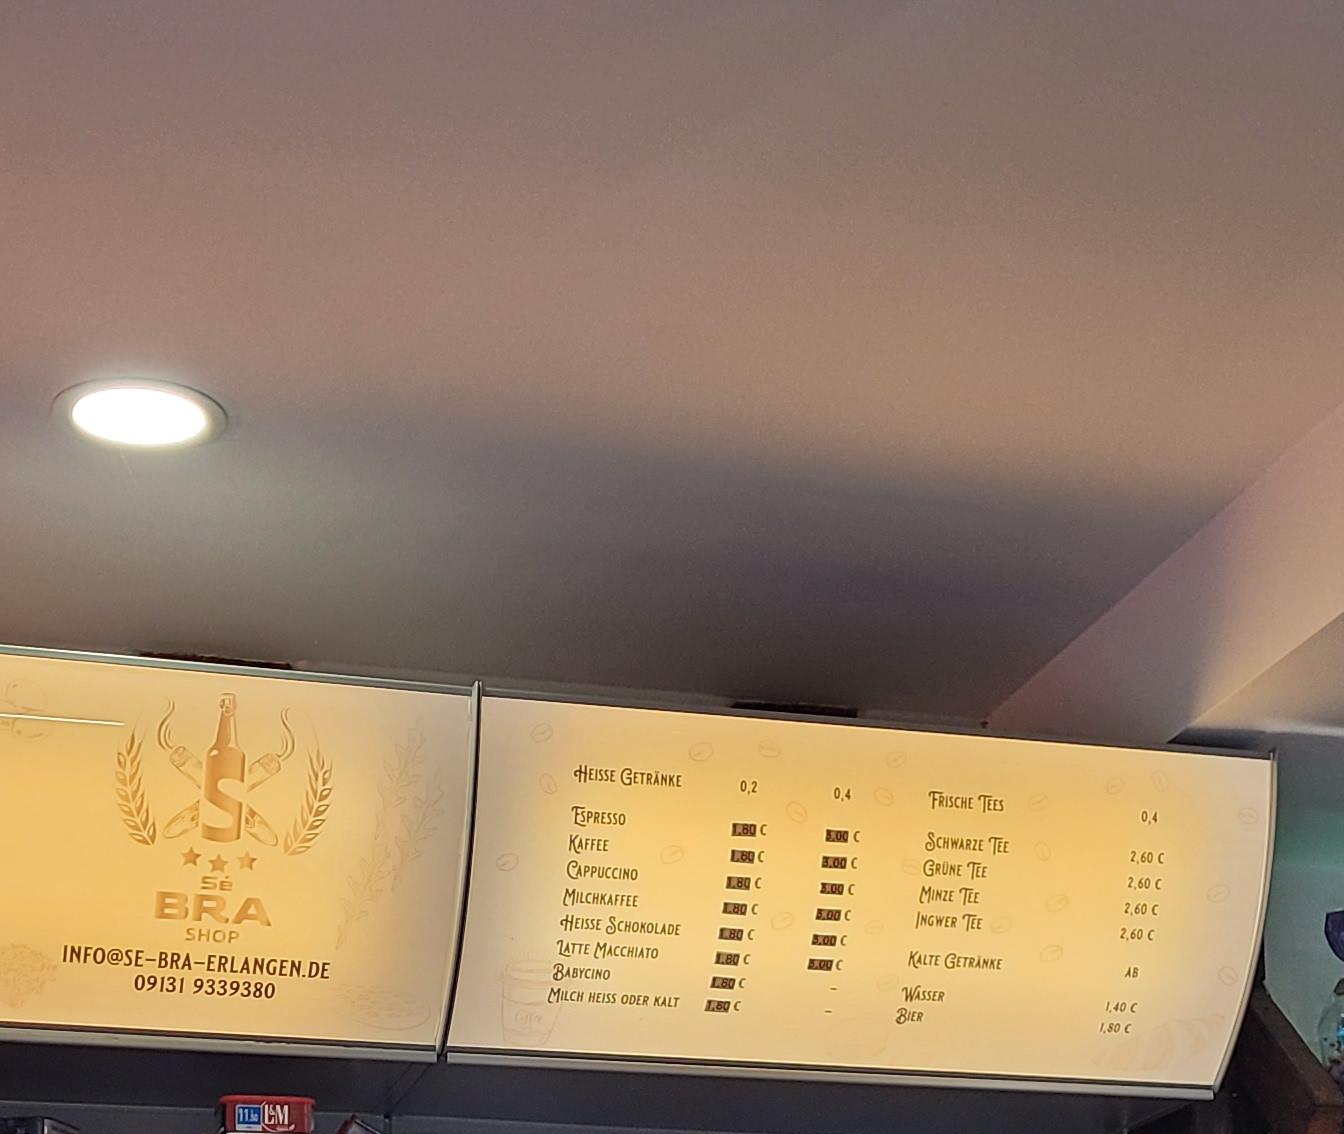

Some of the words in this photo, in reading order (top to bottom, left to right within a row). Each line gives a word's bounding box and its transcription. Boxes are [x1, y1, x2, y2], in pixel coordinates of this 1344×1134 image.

[155, 890, 272, 927] BRA
[185, 927, 240, 944] SHOP
[134, 974, 186, 994] 09131
[192, 977, 276, 999] 9339380
